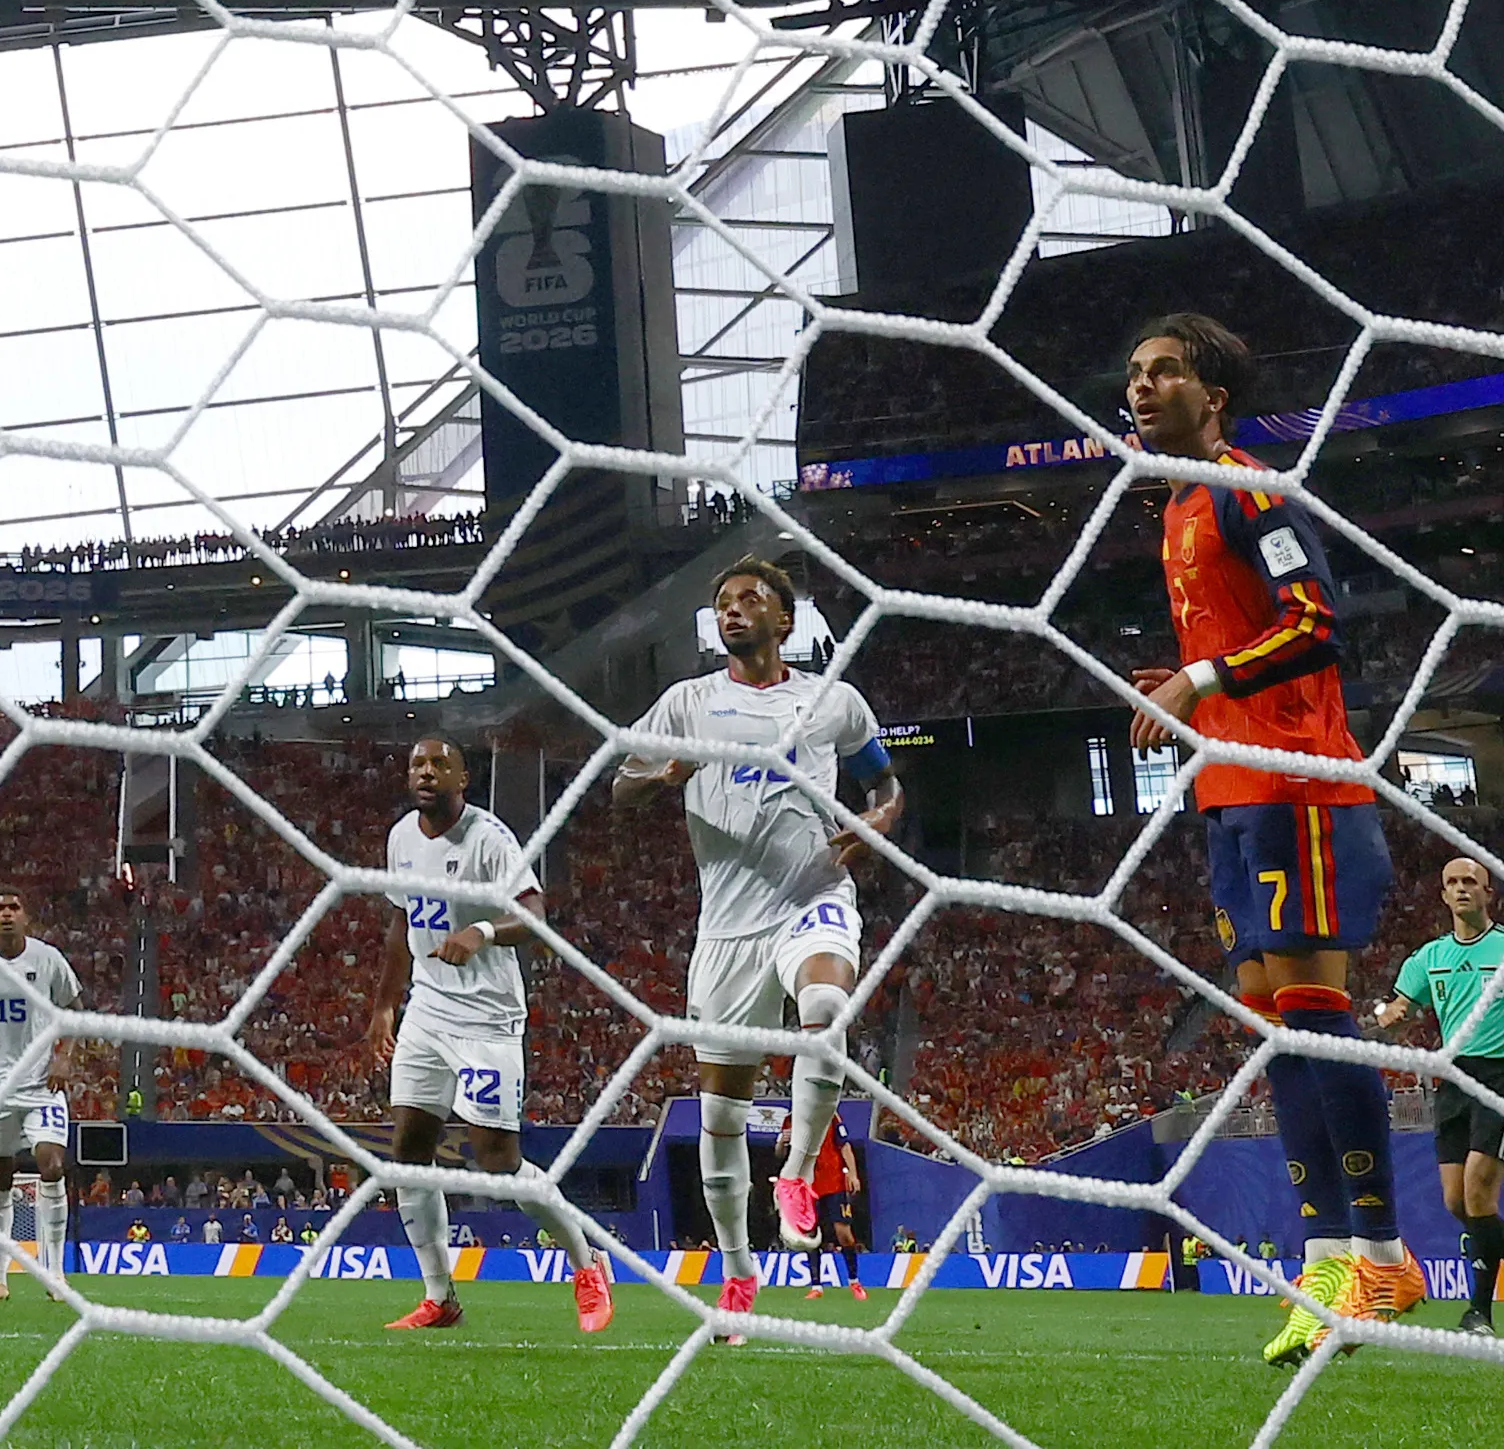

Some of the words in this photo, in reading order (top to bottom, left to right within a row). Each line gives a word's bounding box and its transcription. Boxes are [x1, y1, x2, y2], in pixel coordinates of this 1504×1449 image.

[525, 274, 568, 293] FIFA
[499, 310, 561, 329] WORLD
[562, 307, 599, 324] CUP
[499, 324, 599, 354] 2026
[1005, 433, 1143, 468] ATLANA
[407, 895, 450, 931] 22
[1257, 870, 1288, 931] 7
[458, 1067, 501, 1105] 22
[40, 1105, 66, 1129] 15
[80, 1242, 170, 1276] VISA
[293, 1245, 392, 1280] VISA
[968, 1253, 1074, 1288] VISA
[1424, 1259, 1471, 1300] VISA
